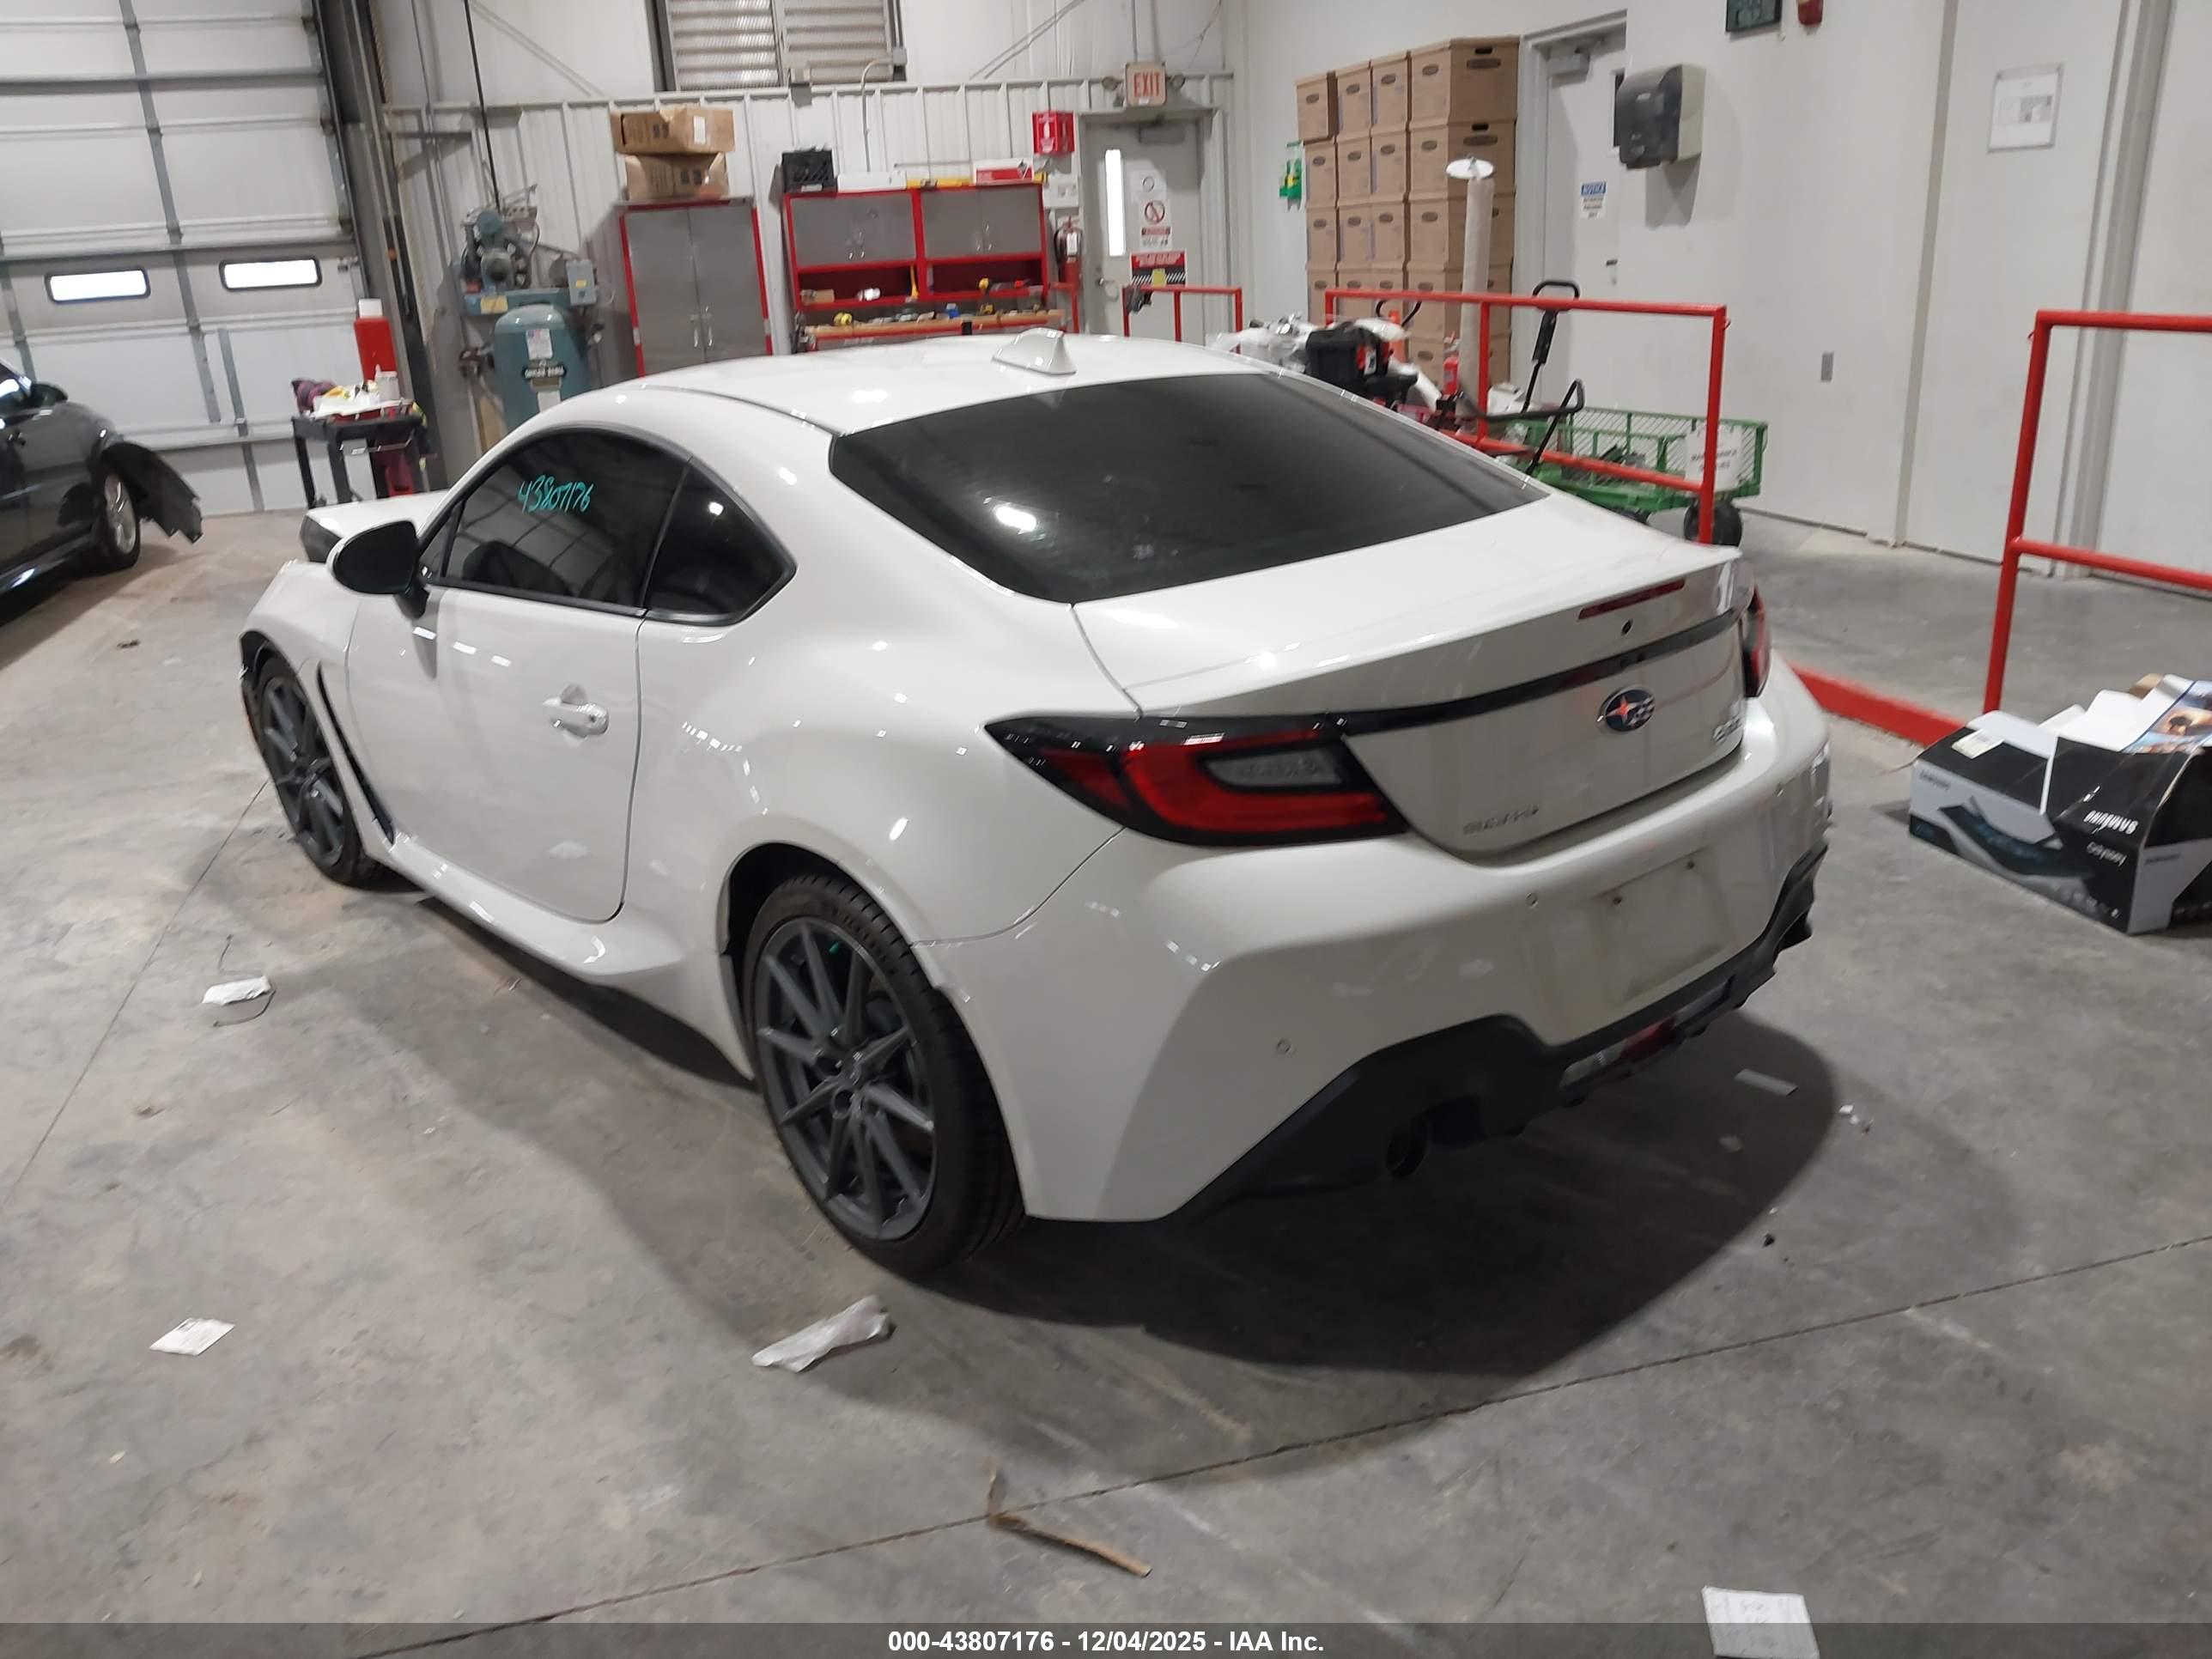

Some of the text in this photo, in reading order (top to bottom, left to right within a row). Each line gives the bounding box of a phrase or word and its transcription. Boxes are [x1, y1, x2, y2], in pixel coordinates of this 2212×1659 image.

[1133, 72, 1161, 97] EXIT
[517, 474, 594, 514] 43807176
[2082, 810, 2139, 835] SAMSUNG
